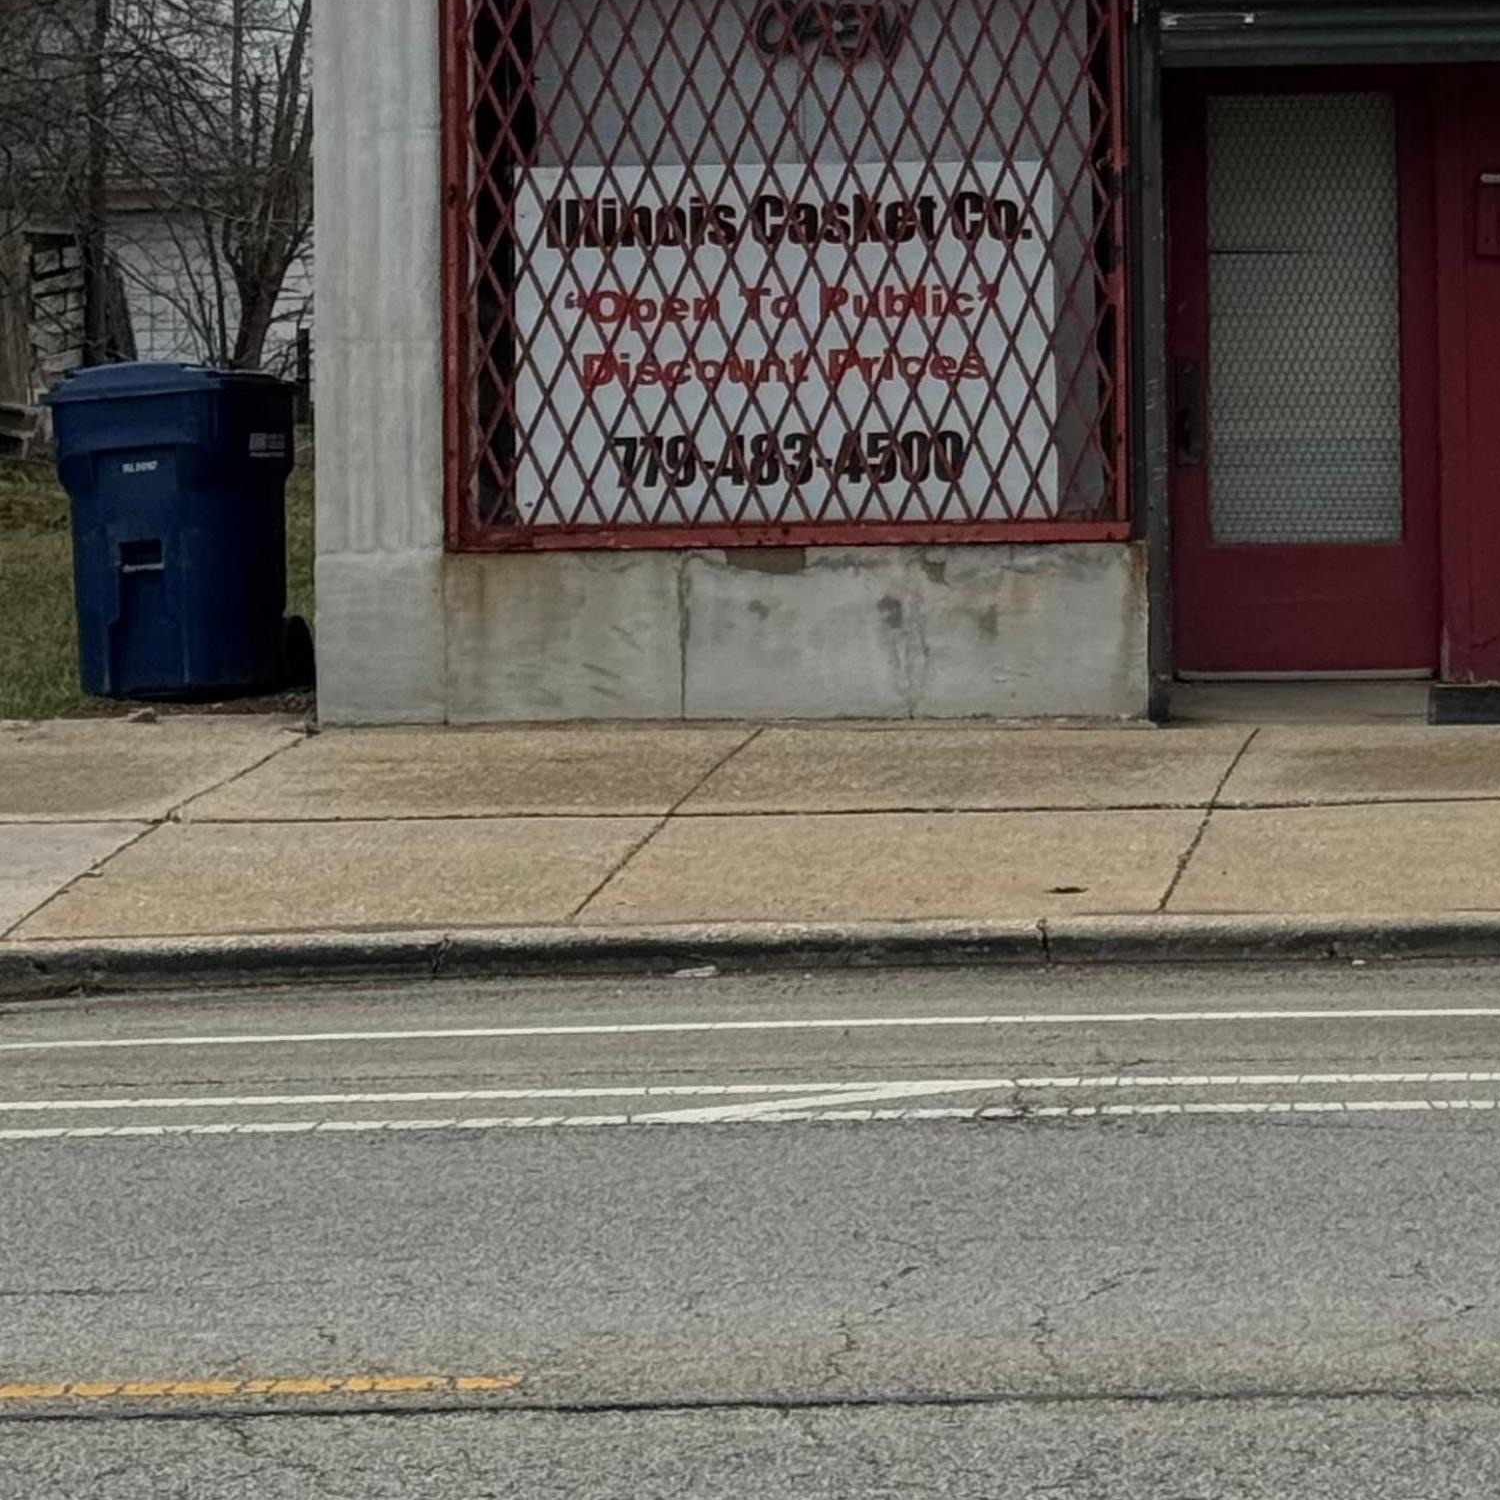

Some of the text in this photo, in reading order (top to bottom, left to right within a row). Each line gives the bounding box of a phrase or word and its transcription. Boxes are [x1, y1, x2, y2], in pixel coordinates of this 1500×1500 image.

[546, 191, 1032, 249] Illinois Casket Co.
[739, 287, 799, 322] To
[583, 349, 986, 386] Discount Prices
